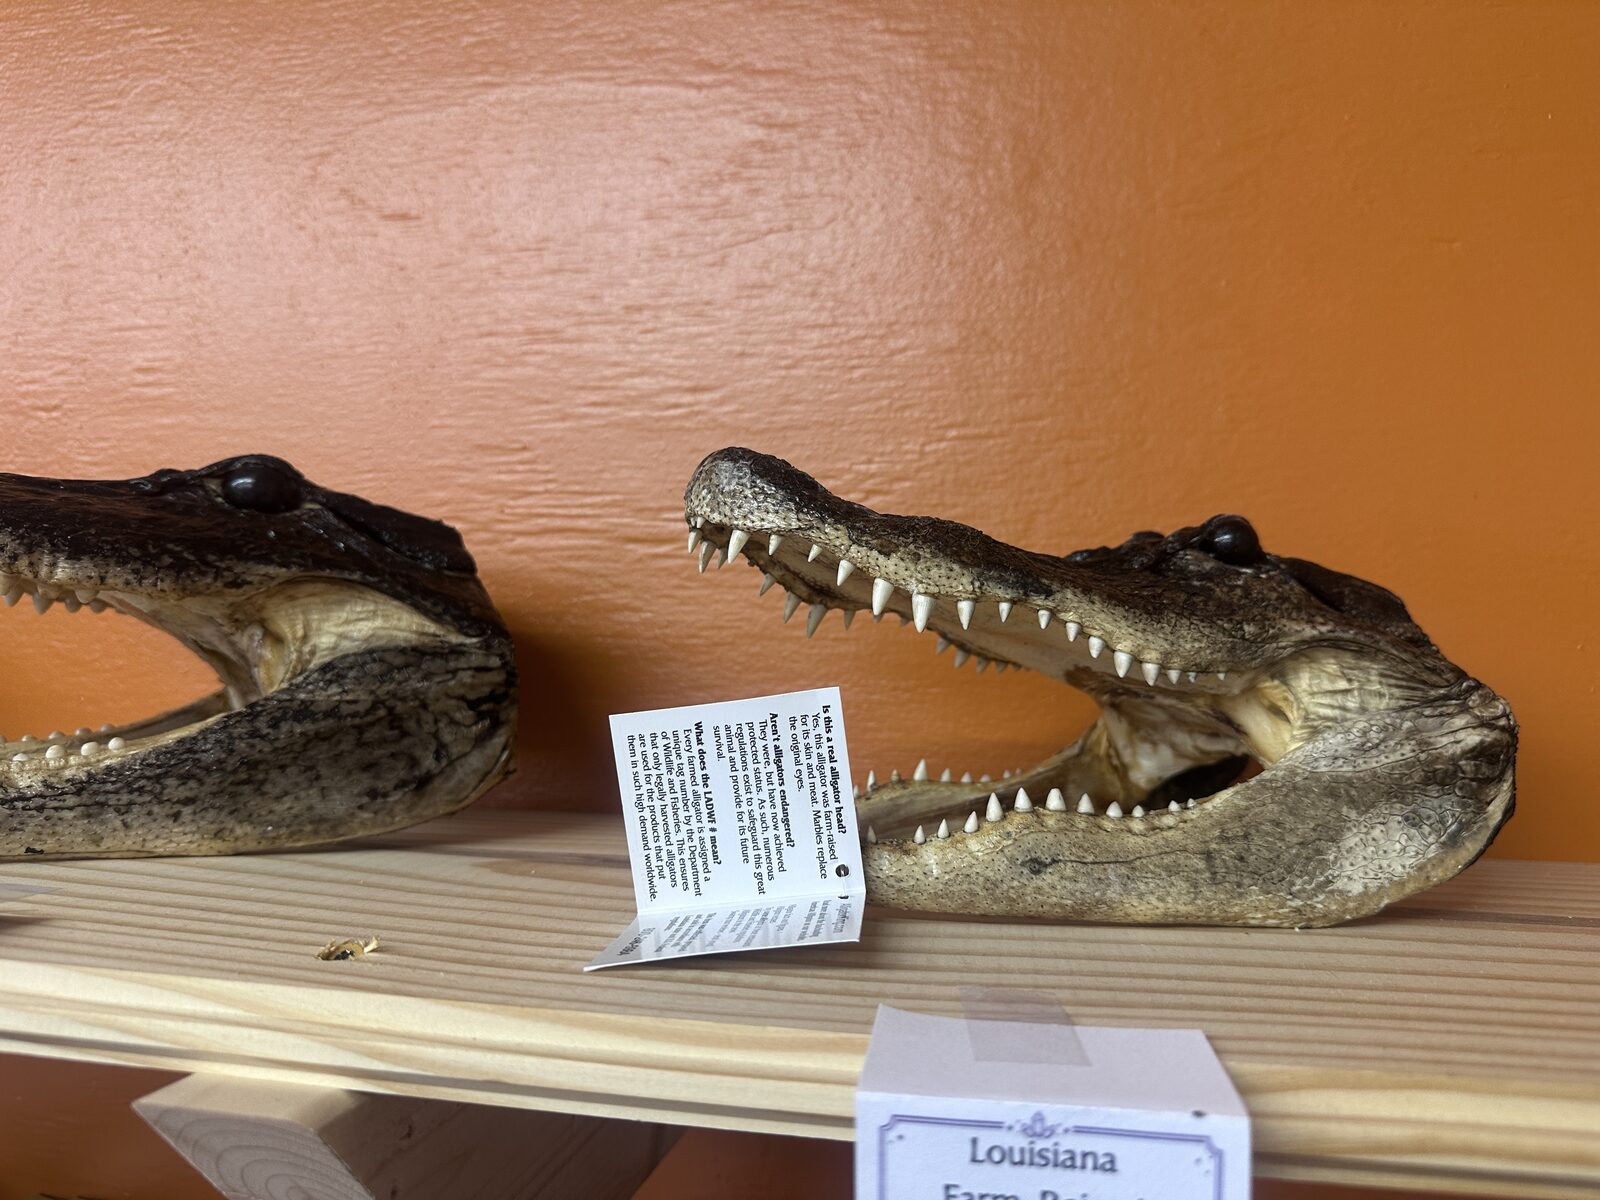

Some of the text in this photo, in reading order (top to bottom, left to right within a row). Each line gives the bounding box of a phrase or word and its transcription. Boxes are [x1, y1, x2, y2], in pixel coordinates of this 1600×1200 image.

[821, 704, 831, 714] Is
[823, 715, 833, 734] this
[683, 728, 693, 753] Every
[693, 720, 705, 746] What
[712, 725, 726, 762] survival.
[686, 755, 700, 787] farmed
[697, 748, 707, 771] does
[788, 715, 805, 792] the original eyes.
[827, 745, 838, 764] real
[700, 772, 710, 789] the
[724, 724, 750, 864] animal and provide for its future
[758, 718, 787, 873] They were, but have now achieved
[769, 712, 795, 848] Aren't alligators endangered?
[799, 714, 828, 879] for its skin and meat. Marbles replace
[811, 712, 839, 860] Yes, this alligator was farm-raised
[829, 765, 841, 804] alligator
[626, 734, 658, 902] them in such high demand worldwide.
[638, 733, 666, 880] are used for the products that put
[649, 732, 678, 888] that only legally harvested alligators
[660, 730, 690, 892] of Wildlife and Fisheries. This ensures
[671, 729, 702, 897] unique tag number by the Department
[690, 788, 703, 824] alligator
[703, 790, 717, 824] LADWF
[734, 722, 766, 895] regulations exist to safeguard this great
[744, 721, 775, 881] protected status. As such, numerous
[834, 806, 847, 834] head?
[696, 826, 706, 834] is
[697, 835, 712, 874] assigned
[709, 835, 722, 865] mean?
[969, 1136, 1118, 1173] Louisiana
